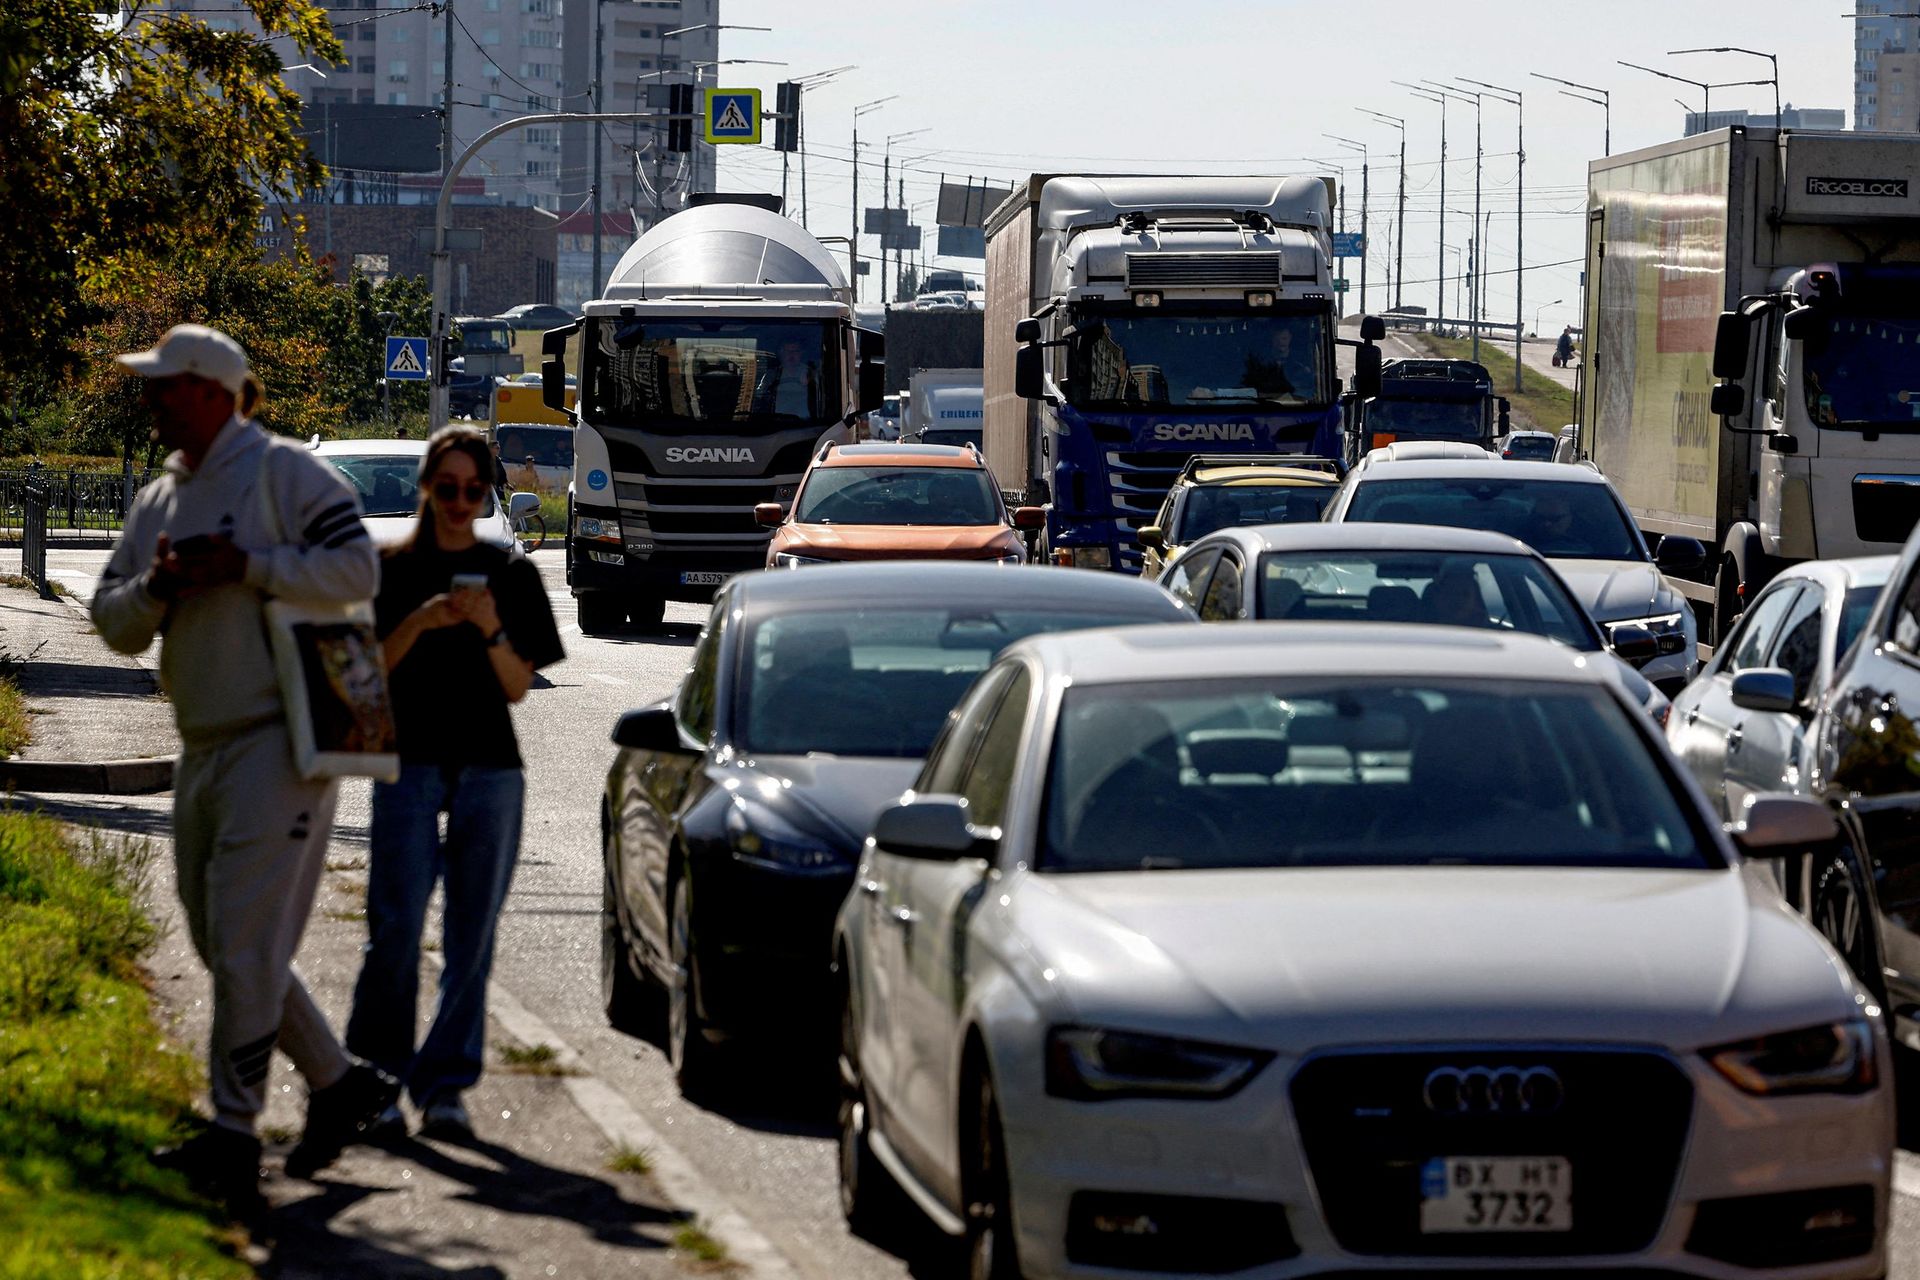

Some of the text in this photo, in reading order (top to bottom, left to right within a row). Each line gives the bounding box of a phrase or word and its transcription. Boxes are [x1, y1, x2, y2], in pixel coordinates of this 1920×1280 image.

[1808, 178, 1905, 196] FRIGOBLOCK
[1154, 423, 1256, 441] SCANIA
[665, 447, 755, 463] SCANIA
[686, 573, 723, 584] AA 3579
[1454, 1163, 1560, 1187] BX HT
[1465, 1191, 1552, 1224] 3732
